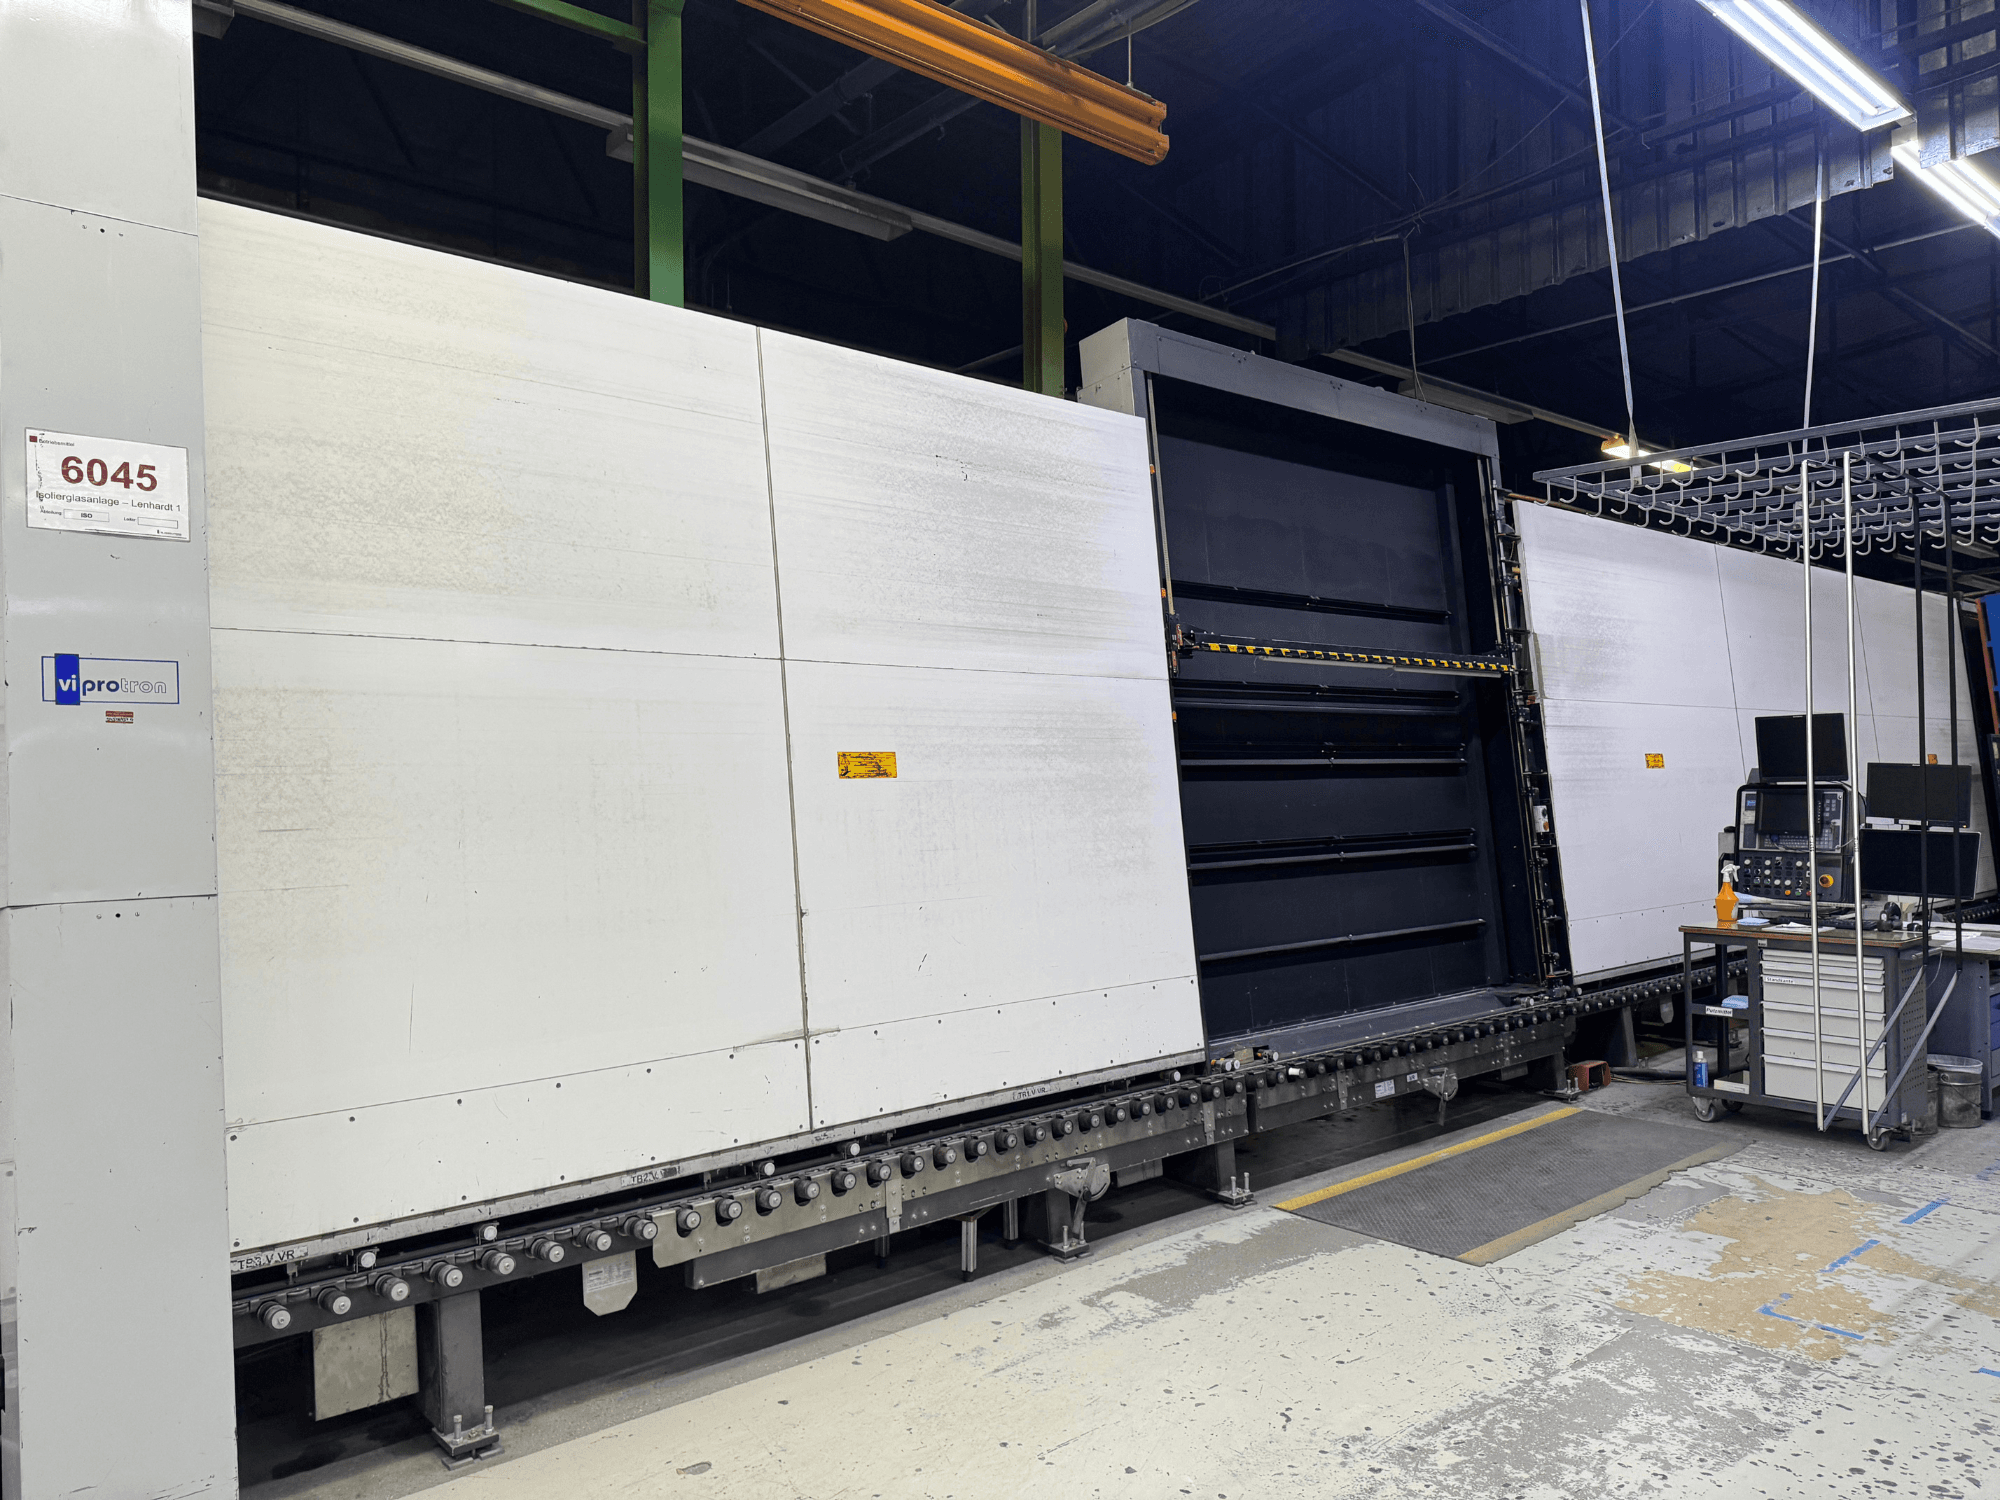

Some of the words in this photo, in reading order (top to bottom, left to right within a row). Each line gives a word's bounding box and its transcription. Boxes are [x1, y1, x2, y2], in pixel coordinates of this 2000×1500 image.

[61, 455, 158, 491] 6045
[35, 490, 120, 507] Isolierglasanlage
[131, 499, 174, 512] Lenhardt
[176, 504, 181, 512] 1
[58, 674, 167, 697] viprotron
[277, 1249, 295, 1261] VR
